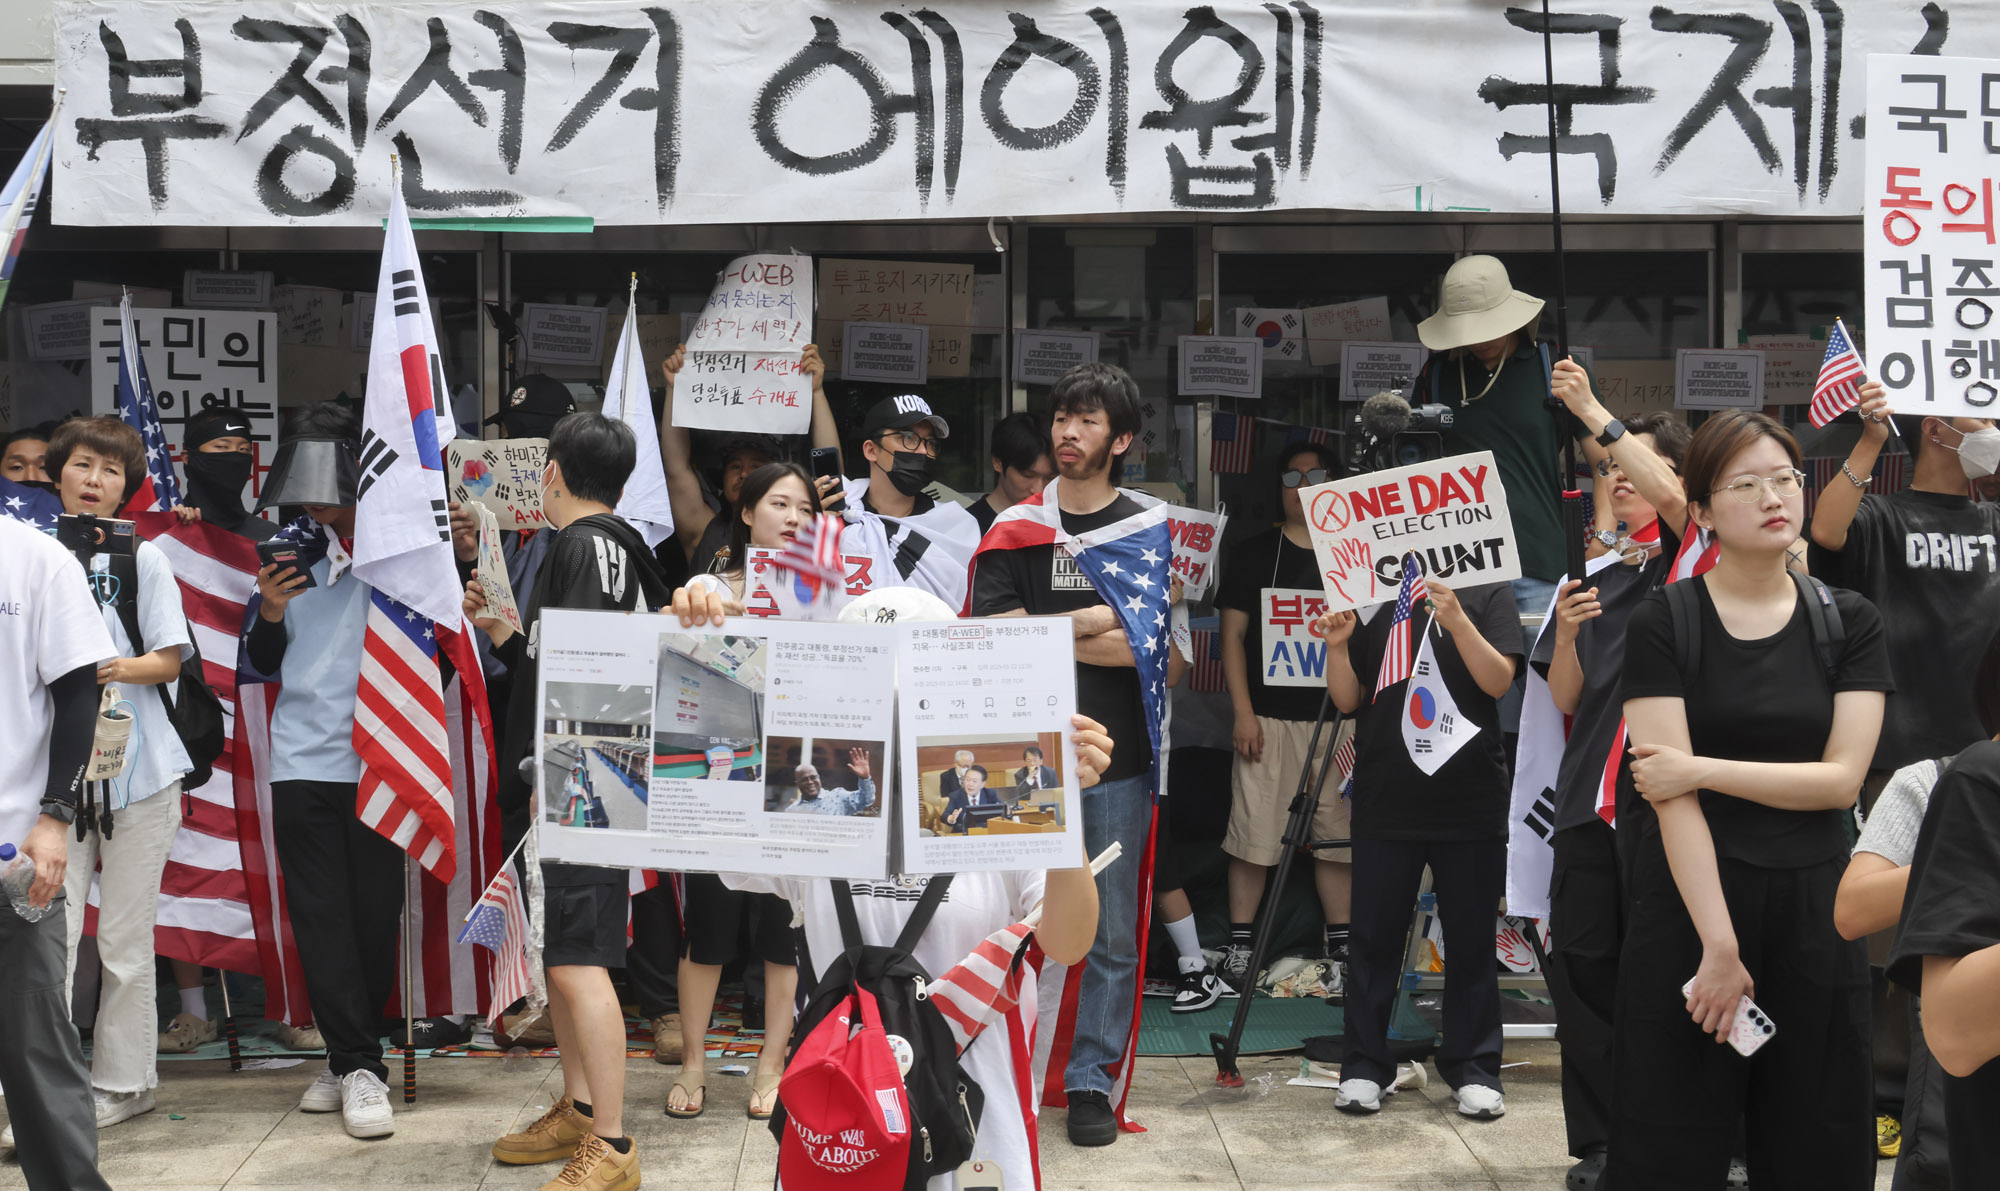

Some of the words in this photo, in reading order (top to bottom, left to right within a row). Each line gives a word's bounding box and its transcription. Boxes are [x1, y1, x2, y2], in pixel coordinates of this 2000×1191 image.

[75, 6, 684, 217] 부정선거
[751, 1, 1324, 214] 에이웹
[1478, 0, 1950, 207] 국제
[832, 270, 906, 296] 투표용지
[912, 272, 970, 295] 지키자!
[1880, 254, 2000, 329] 검증
[692, 351, 746, 373] 부정선거
[1880, 338, 2000, 407] 이행
[692, 383, 744, 406] 당일투표
[748, 387, 800, 408] 수개표
[1440, 413, 1454, 423] KBS
[1408, 464, 1488, 515] DAY
[1372, 504, 1492, 540] ELECTION
[1905, 532, 1998, 573] DRIFT
[912, 629, 920, 639] 윤
[922, 629, 948, 638] 대통령
[986, 627, 993, 636] 등
[996, 626, 1029, 636] 부정선거
[1032, 625, 1048, 635] 거점
[940, 641, 974, 651] 사실조회
[977, 640, 993, 650] 신청
[791, 1117, 833, 1144] UMP
[840, 1129, 864, 1147] WAS
